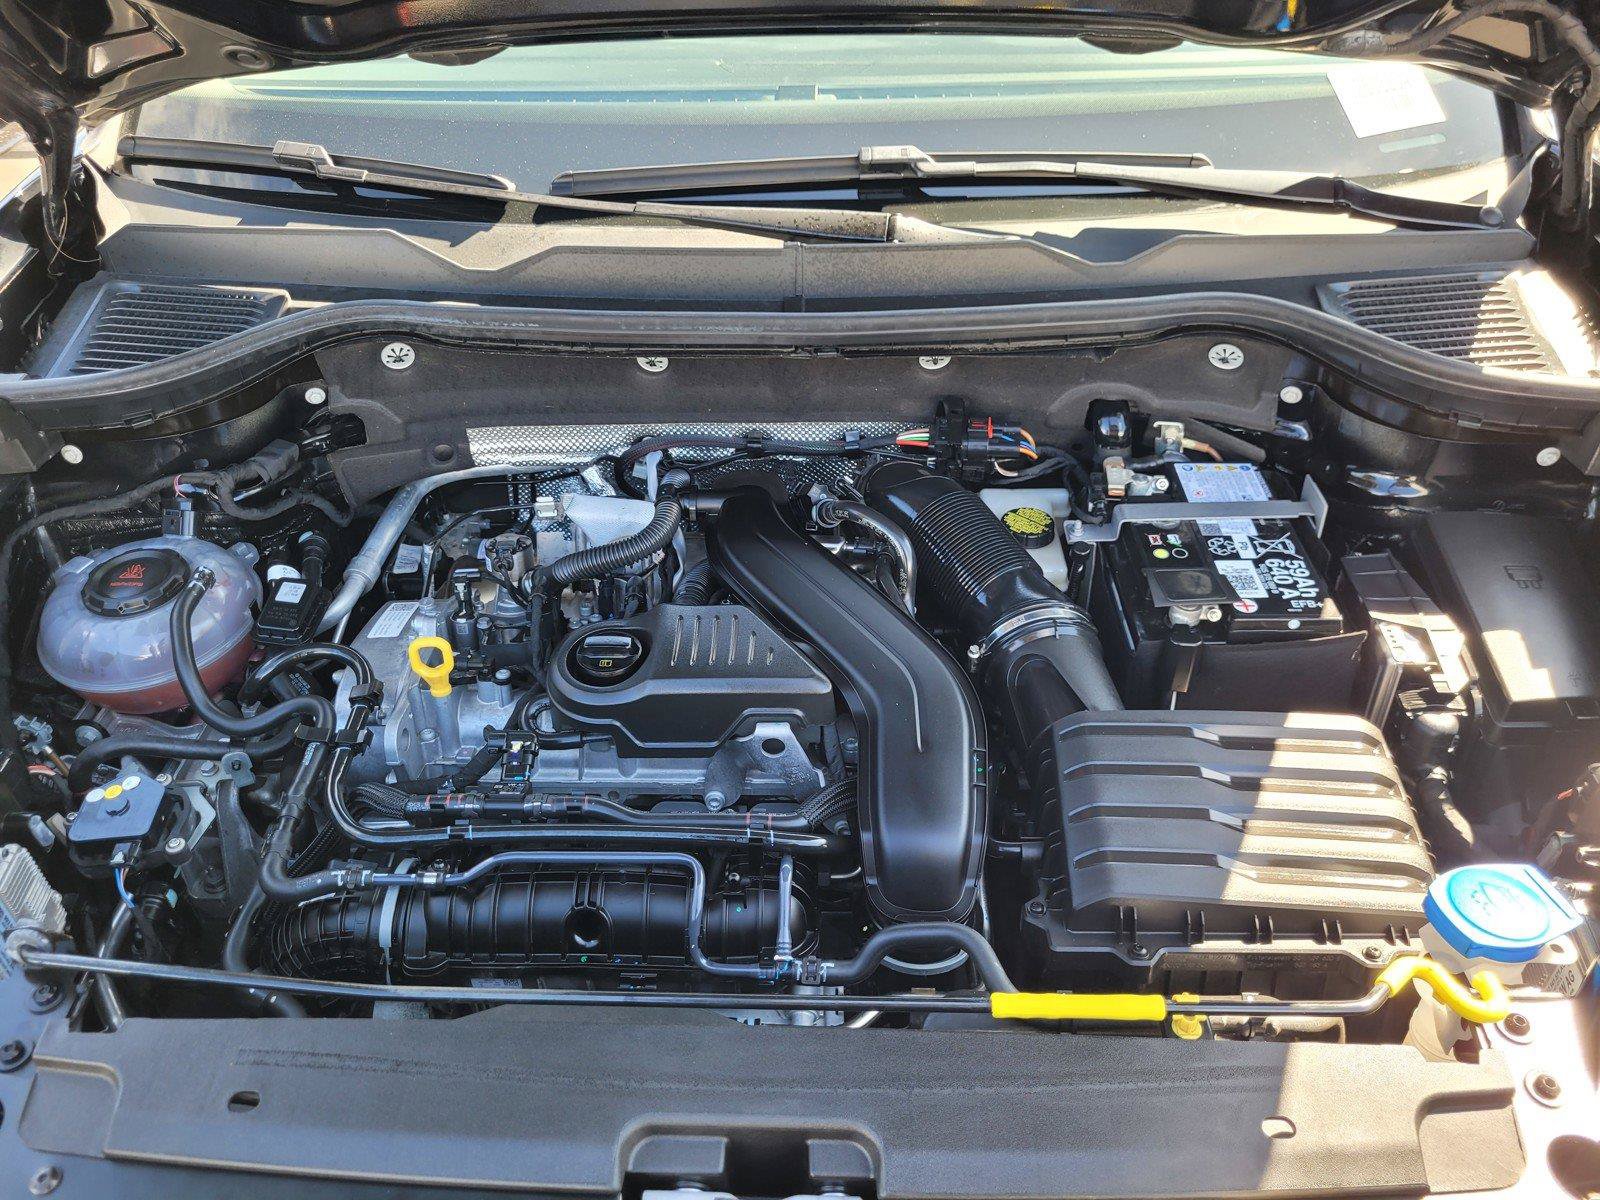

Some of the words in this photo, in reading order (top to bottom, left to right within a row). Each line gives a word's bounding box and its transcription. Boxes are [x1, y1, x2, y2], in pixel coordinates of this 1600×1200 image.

[1265, 558, 1294, 584] 640
[1285, 560, 1320, 597] 59Ah
[1278, 587, 1300, 599] A
[1290, 600, 1324, 608] EFB+
